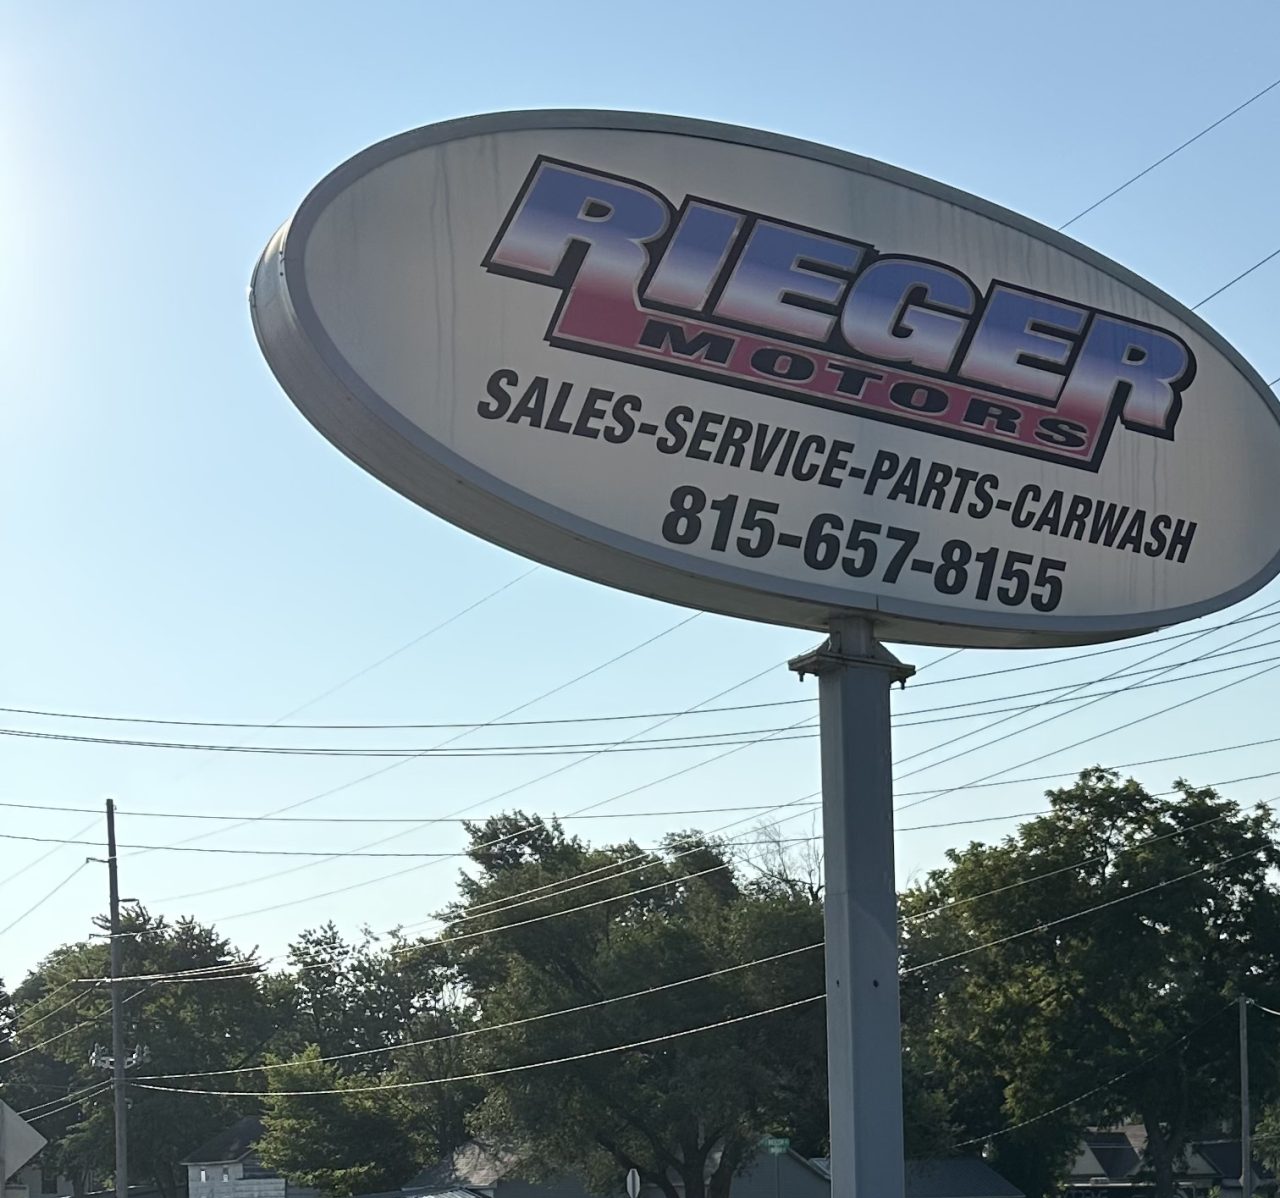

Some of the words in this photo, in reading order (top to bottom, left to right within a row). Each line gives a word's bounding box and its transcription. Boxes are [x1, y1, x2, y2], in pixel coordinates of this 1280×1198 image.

[482, 155, 1197, 440] RIEGER
[639, 319, 1089, 448] MOTORS
[477, 369, 1197, 564] SALES-SERVICE-PARTS-CARWASH
[661, 485, 1067, 613] 815-657-8155
